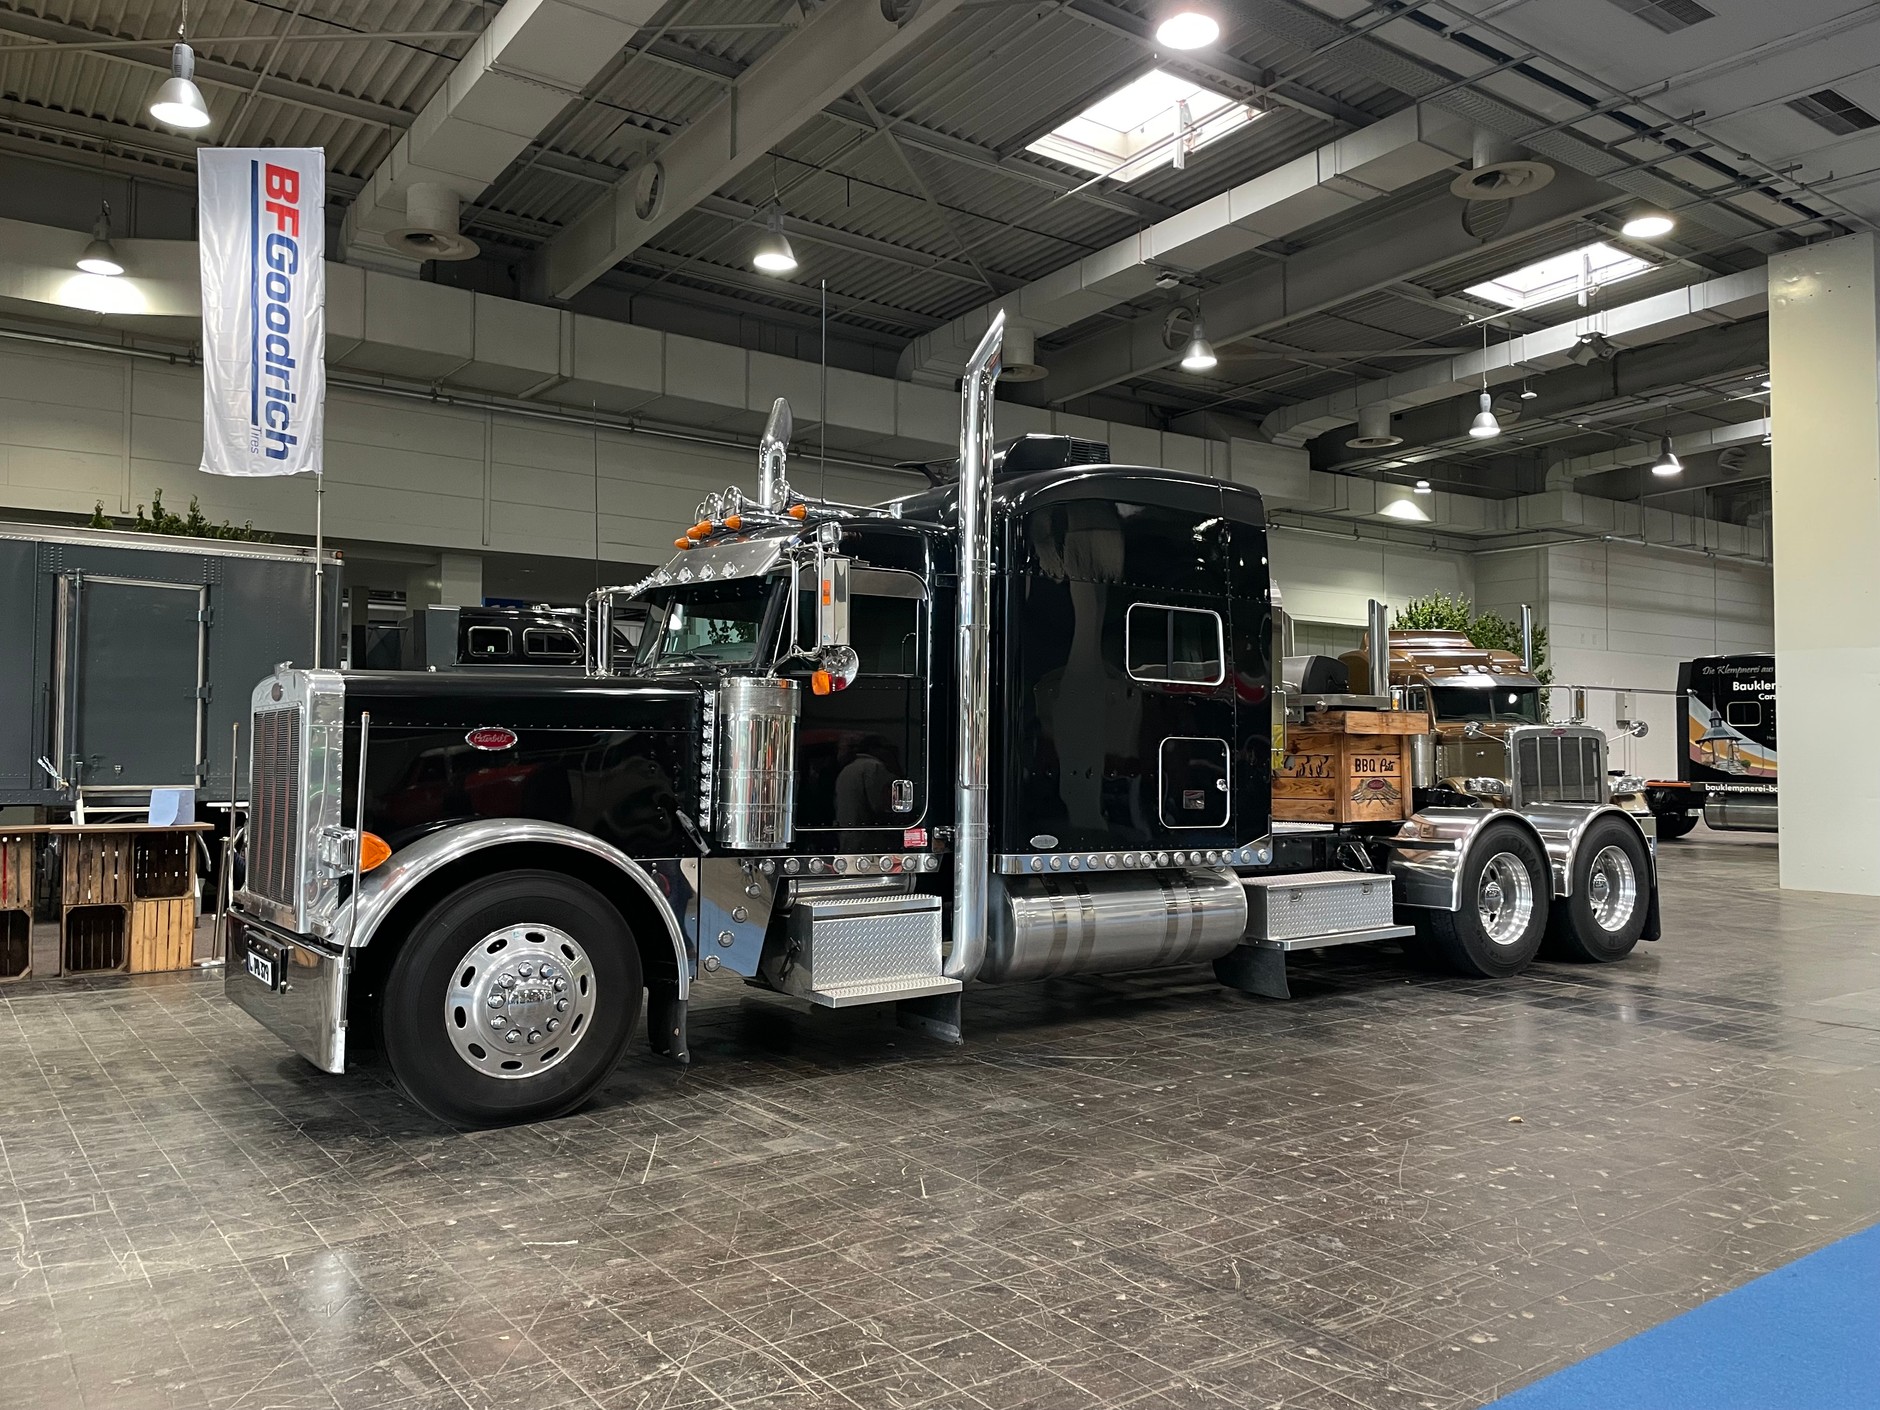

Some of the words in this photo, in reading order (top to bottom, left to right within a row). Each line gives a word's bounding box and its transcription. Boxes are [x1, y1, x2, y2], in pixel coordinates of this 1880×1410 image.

[265, 163, 300, 460] BFGoodrich
[250, 427, 262, 454] Tires
[1702, 666, 1715, 675] Die
[1355, 758, 1376, 772] BBQ
